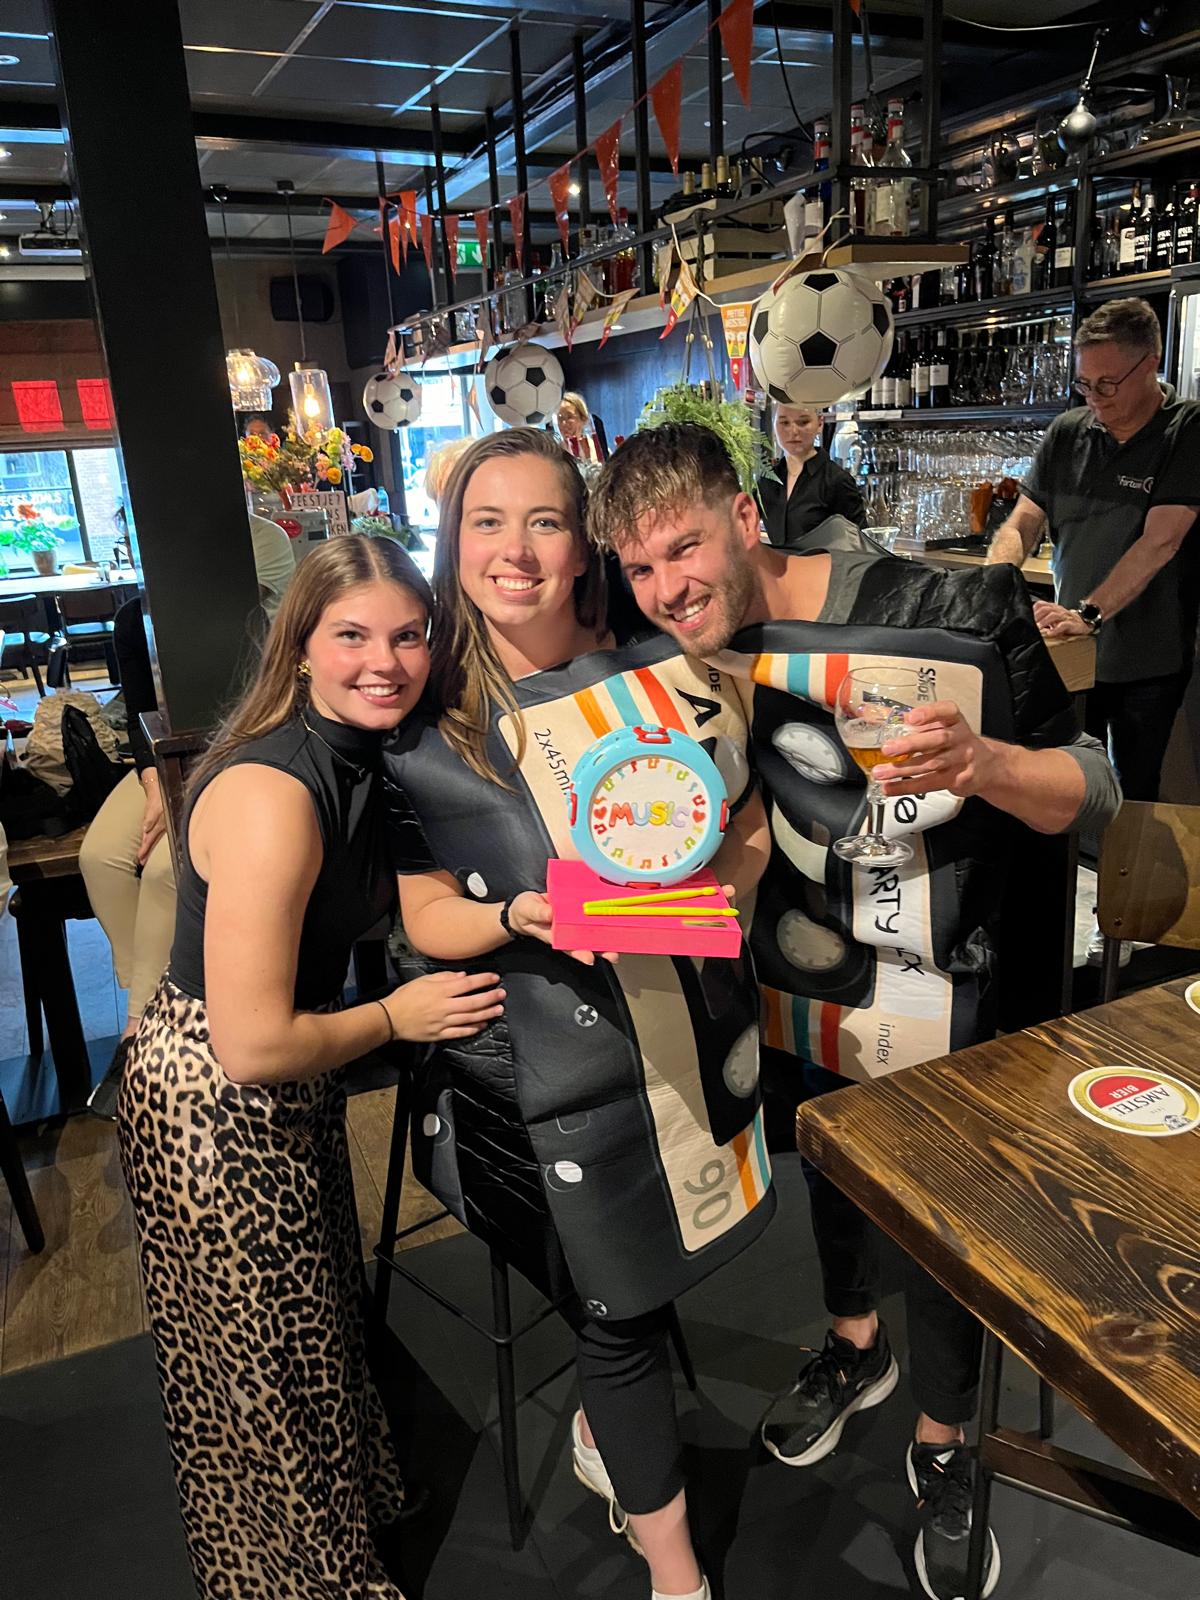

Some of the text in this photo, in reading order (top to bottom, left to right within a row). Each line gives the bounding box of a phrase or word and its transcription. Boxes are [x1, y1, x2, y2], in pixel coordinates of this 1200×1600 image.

[706, 664, 721, 692] IDE
[674, 687, 722, 728] A
[534, 728, 570, 795] 2x45mi
[609, 800, 690, 828] MUSIC
[868, 866, 901, 934] ARTY
[876, 1023, 895, 1066] index
[1109, 1084, 1140, 1099] BIER
[1109, 1087, 1170, 1115] AMSTEL
[683, 1159, 732, 1229] 90
